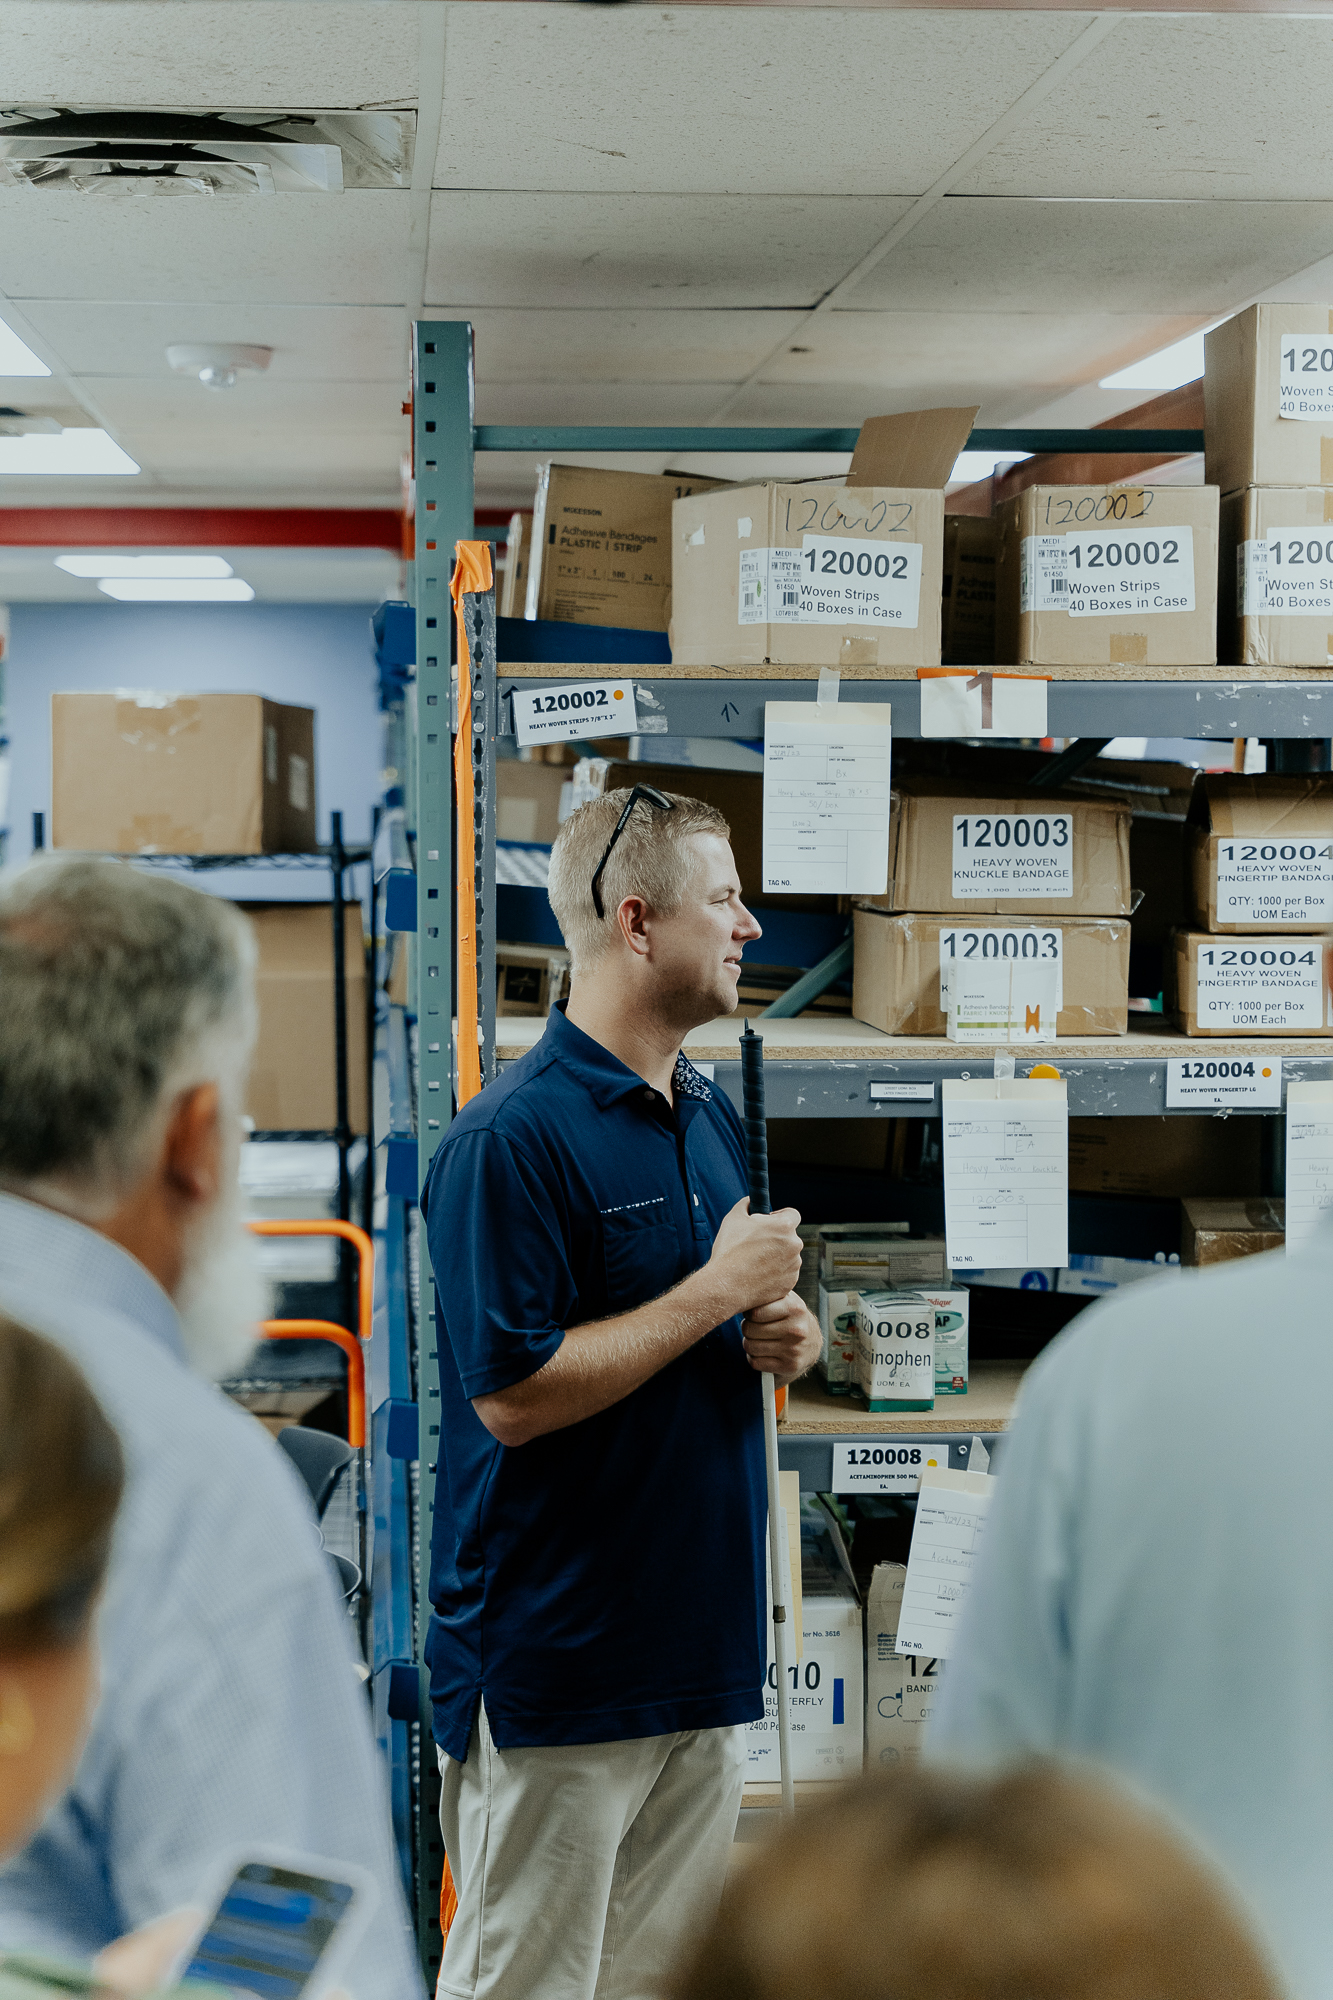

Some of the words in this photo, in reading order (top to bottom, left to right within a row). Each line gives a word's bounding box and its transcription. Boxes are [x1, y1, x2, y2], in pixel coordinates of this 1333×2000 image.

[1281, 386, 1323, 396] Woven
[1281, 402, 1295, 411] 40
[1046, 491, 1154, 525] 120002
[562, 526, 607, 539] Adhesive
[610, 530, 658, 544] Bandages
[560, 538, 600, 550] PLASTIC
[614, 543, 642, 553] STRIP
[1069, 540, 1179, 568] 120002
[804, 548, 909, 580] 120002
[1069, 583, 1115, 594] Woven
[1120, 580, 1160, 593] Strips
[1268, 579, 1314, 590] Woven
[800, 585, 841, 599] Woven
[844, 588, 880, 603] Strips
[1070, 600, 1085, 611] 40
[1090, 598, 1132, 610] Boxes
[1137, 597, 1149, 608] in
[1154, 596, 1188, 607] Case
[1268, 597, 1284, 608] 40
[1289, 596, 1331, 607] Boxes
[799, 601, 813, 612] 40
[817, 602, 853, 615] Boxes
[858, 605, 869, 616] in
[872, 606, 903, 619] Case
[532, 689, 609, 715] 120002
[966, 672, 993, 729] 1
[529, 722, 547, 730] HEAVY
[548, 719, 568, 728] WOVEN
[569, 717, 590, 725] STRIPS
[957, 819, 1069, 847] 120003
[973, 859, 1012, 867] HEAVY
[1015, 858, 1058, 866] WOVEN
[954, 870, 1009, 878] KNUCKLE
[1013, 870, 1069, 878] BANDAGE
[1229, 896, 1254, 905] QTY:
[1258, 896, 1281, 905] 1000
[1285, 898, 1301, 907] per
[1305, 896, 1325, 905] Box
[1253, 910, 1277, 918] UOM
[1282, 910, 1306, 918] Each
[944, 933, 1058, 958] 120003
[1202, 951, 1316, 965] 120004
[1209, 1001, 1234, 1010] QTY:
[1238, 1001, 1261, 1010] 1000
[1265, 1003, 1281, 1012] per
[1285, 1001, 1304, 1010] Box
[1233, 1015, 1257, 1023] UOM
[1262, 1015, 1286, 1023] Each
[1182, 1062, 1255, 1078] 120004
[962, 1162, 989, 1180] Heavy
[1000, 1164, 1022, 1173] Woven
[972, 1195, 1025, 1204] 120003
[848, 1449, 922, 1465] 120008
[765, 1697, 824, 1706] BUERFLY
[750, 1722, 767, 1731] 2400
[770, 1722, 779, 1731] Pe
[790, 1723, 806, 1731] ase
